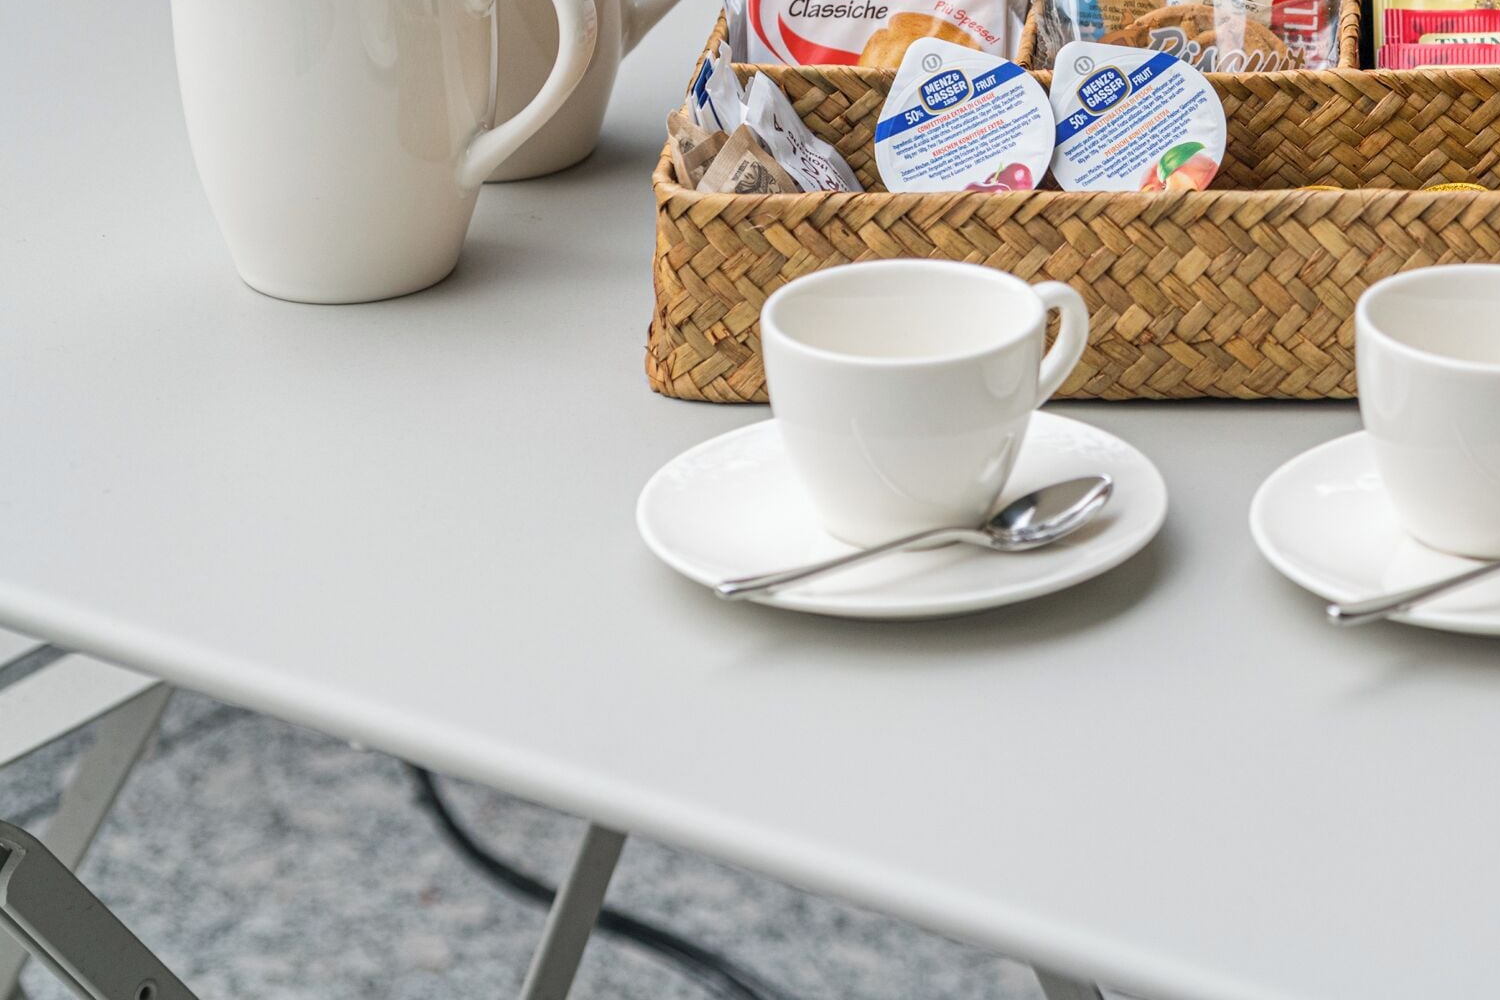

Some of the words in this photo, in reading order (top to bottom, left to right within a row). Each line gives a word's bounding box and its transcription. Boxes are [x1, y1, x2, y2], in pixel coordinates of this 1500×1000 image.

[953, 9, 999, 44] Spesse!
[975, 74, 997, 92] FRUIT
[1132, 67, 1153, 86] FRUIT
[926, 81, 967, 106] GASSER
[1087, 78, 1125, 108] GASSER
